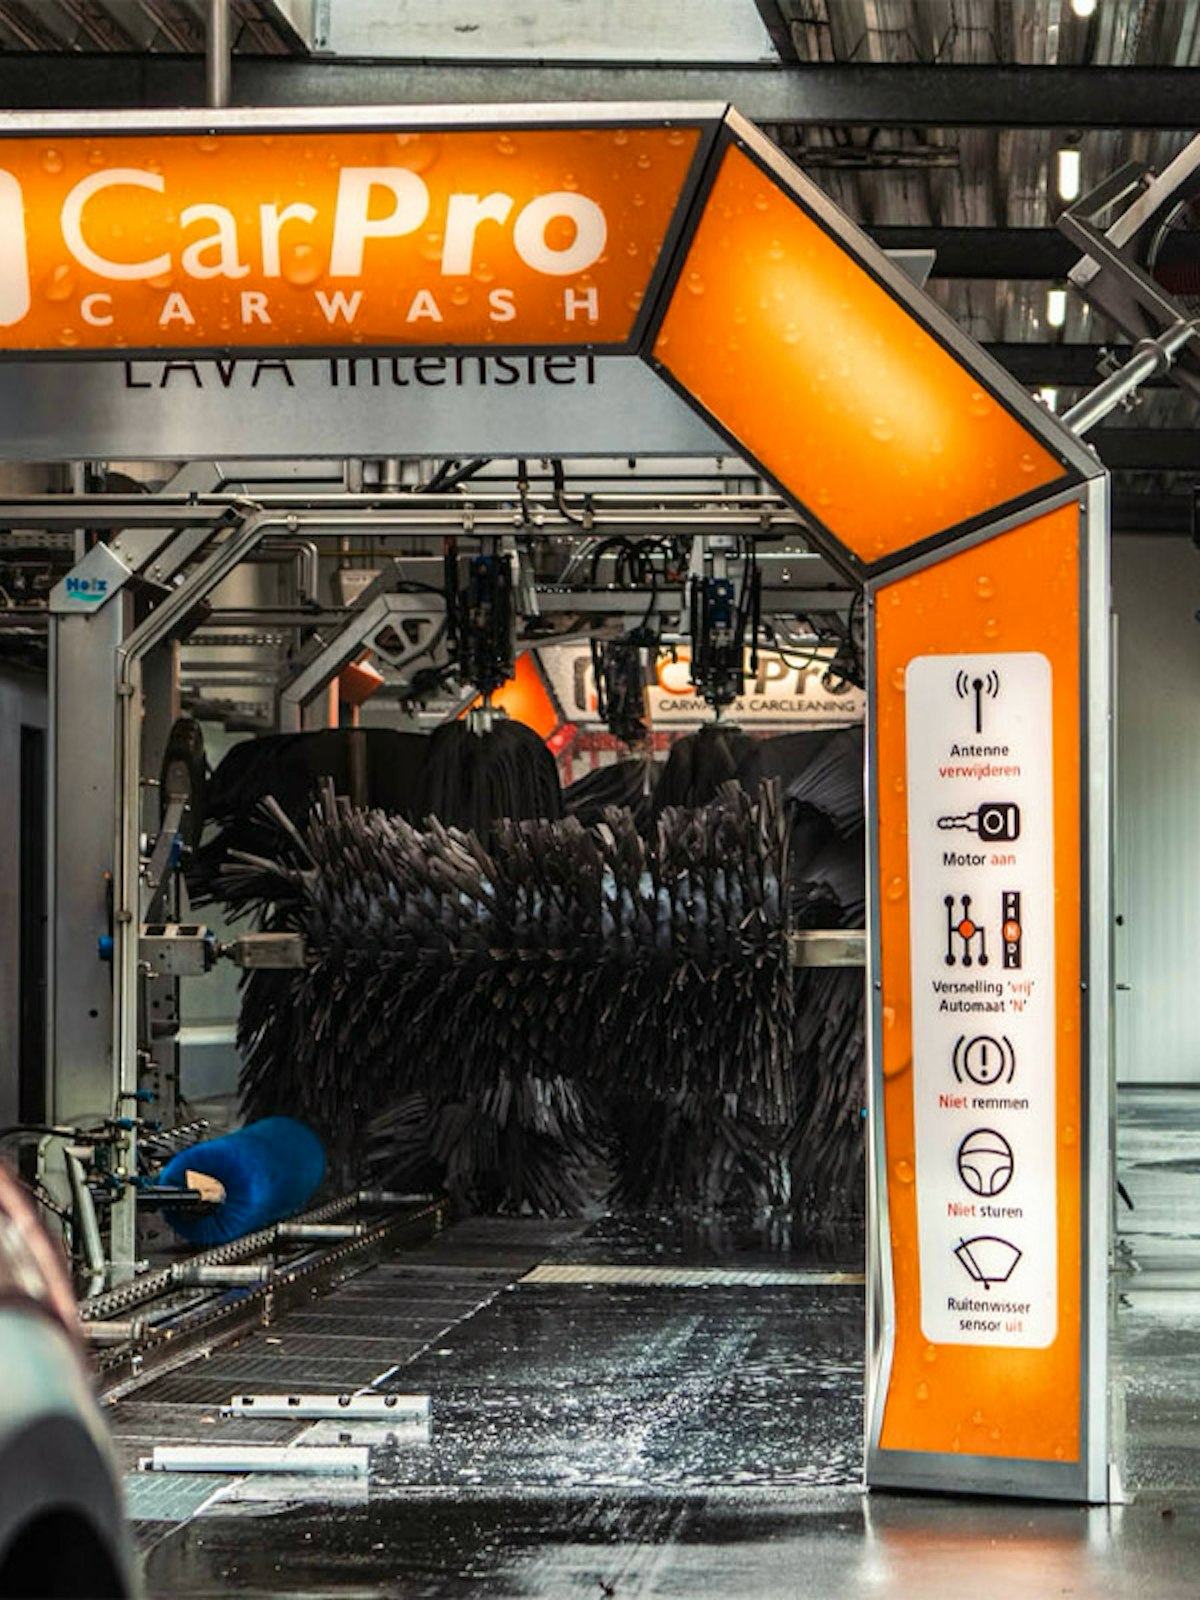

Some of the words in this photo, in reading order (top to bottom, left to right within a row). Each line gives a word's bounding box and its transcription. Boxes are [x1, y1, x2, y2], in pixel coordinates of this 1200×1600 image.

[60, 166, 608, 281] CarPro
[80, 287, 599, 326] CARWASH
[657, 656, 854, 695] CPro
[749, 699, 855, 712] CARCLEANING
[950, 744, 1009, 757] Antenne
[938, 763, 1021, 781] verwijderen
[943, 853, 986, 866] Motor
[990, 854, 1016, 866] aan
[932, 980, 1003, 996] Versnelling
[940, 1000, 1005, 1012] Automaat
[939, 1094, 968, 1109] Niet
[972, 1097, 1029, 1109] remmen
[947, 1202, 975, 1217] Niet
[980, 1204, 1023, 1218] sturen
[947, 1297, 1031, 1314] Ruitenwisser
[959, 1319, 1001, 1331] sensor
[1005, 1317, 1023, 1332] uit
